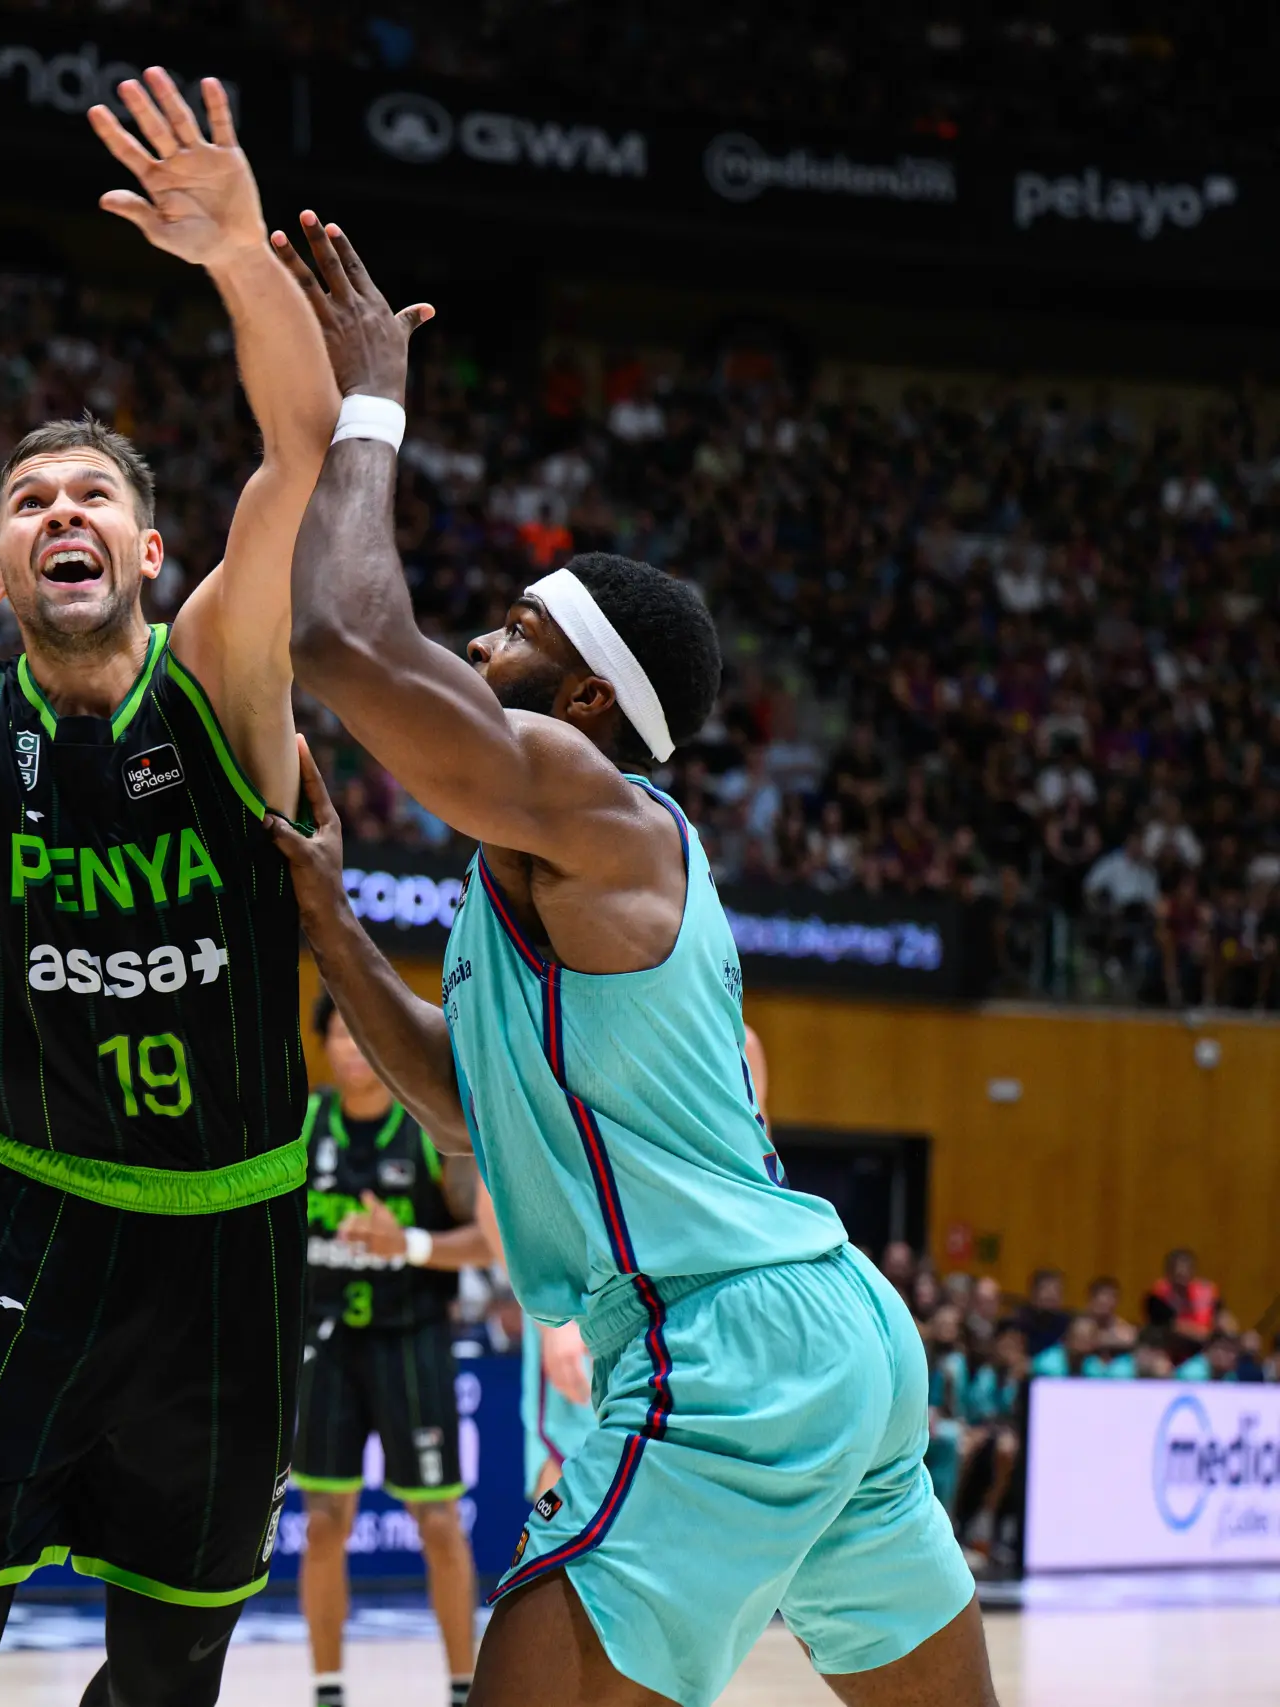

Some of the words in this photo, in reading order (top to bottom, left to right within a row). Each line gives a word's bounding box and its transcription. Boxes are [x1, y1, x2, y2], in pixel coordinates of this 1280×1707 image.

[459, 111, 648, 177] GWM
[1014, 167, 1204, 240] pelayo
[127, 766, 152, 783] liga
[132, 768, 180, 793] endesa
[10, 827, 224, 918] PENYA
[98, 1032, 193, 1117] 19
[342, 1280, 373, 1328] 3
[537, 1499, 552, 1518] acb
